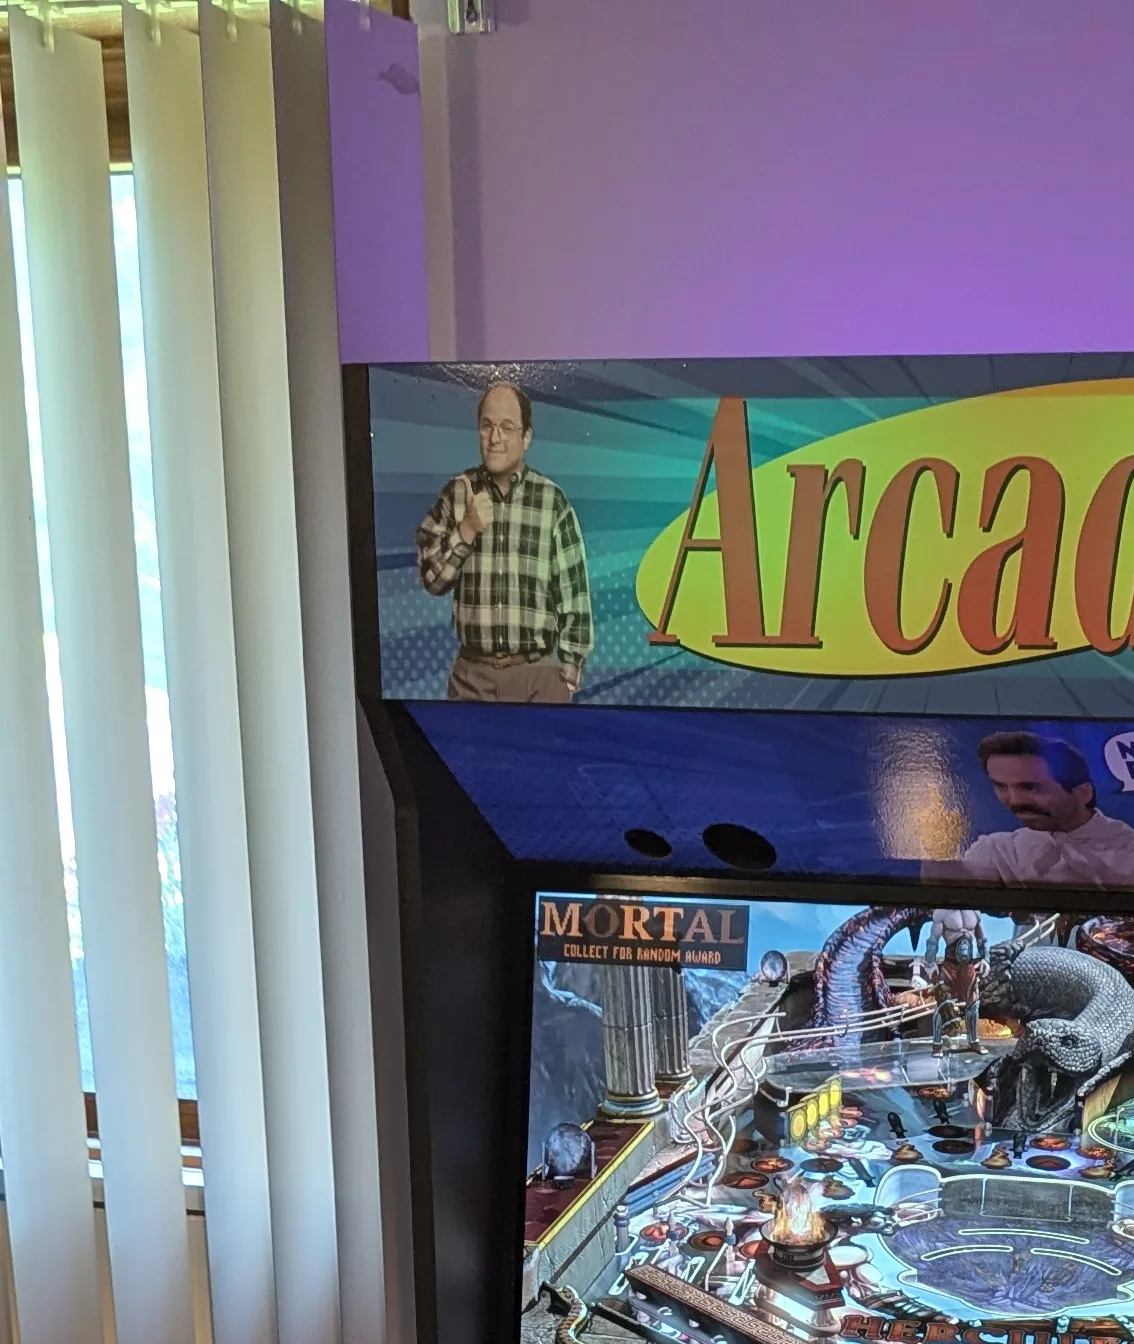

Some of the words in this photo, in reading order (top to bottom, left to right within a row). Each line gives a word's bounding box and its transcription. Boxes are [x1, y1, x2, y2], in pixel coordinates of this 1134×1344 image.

[540, 901, 745, 945] MORTAL
[563, 944, 608, 960] COLLECT
[613, 946, 633, 960] FOR
[637, 947, 681, 962] RANDOM
[685, 950, 721, 965] AWARD
